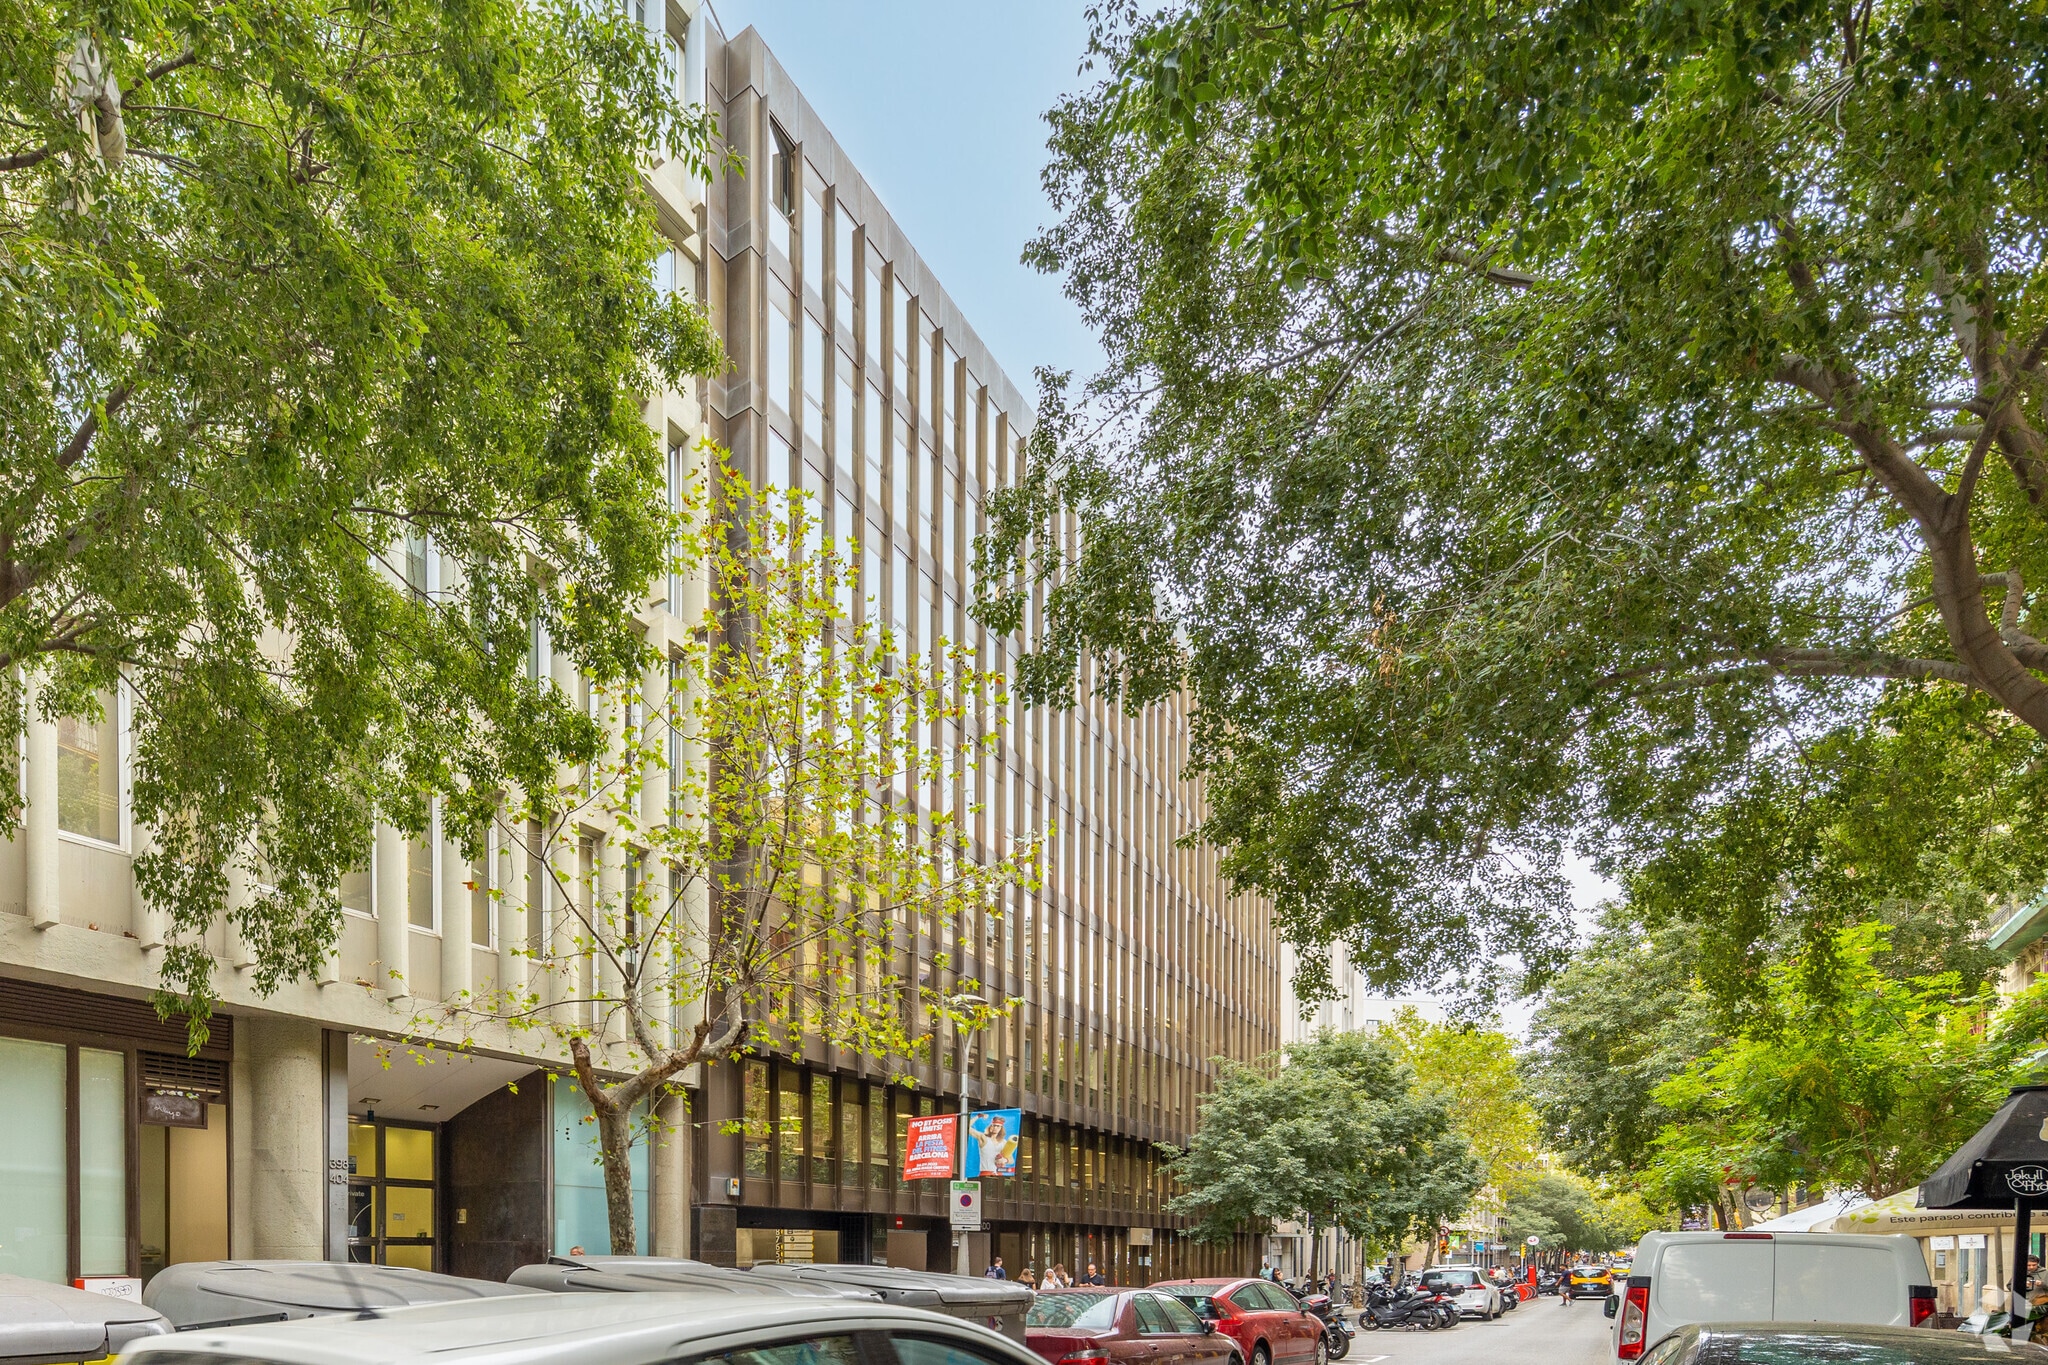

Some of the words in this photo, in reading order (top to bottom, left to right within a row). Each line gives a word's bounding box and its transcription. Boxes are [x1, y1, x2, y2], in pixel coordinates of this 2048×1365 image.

[912, 1120, 923, 1128] NO
[918, 1133, 942, 1141] ARRIBA
[909, 1152, 949, 1161] BARCELONA
[330, 1159, 349, 1170] 398
[330, 1173, 349, 1184] 404
[2004, 1169, 2043, 1182] Jekyll
[2022, 1180, 2048, 1191] Hyd
[1890, 1216, 1916, 1224] Este
[1919, 1213, 1964, 1223] parasol
